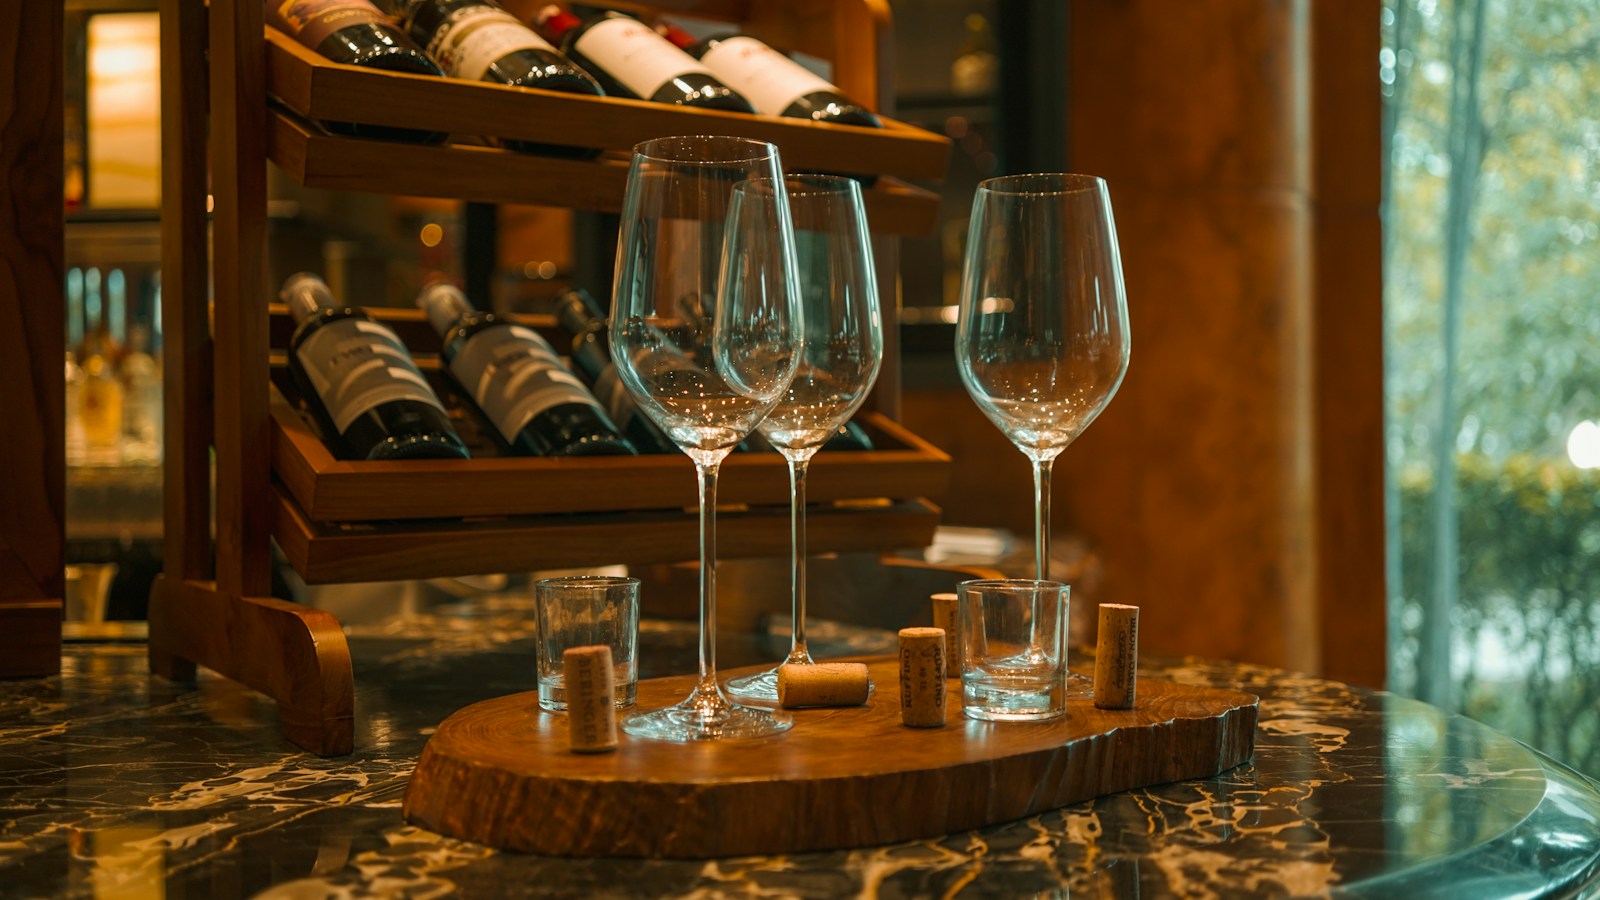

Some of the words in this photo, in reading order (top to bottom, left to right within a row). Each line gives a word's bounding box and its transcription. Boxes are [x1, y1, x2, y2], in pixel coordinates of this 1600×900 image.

[1129, 617, 1137, 651] NOTRI
[578, 658, 598, 744] BERINGER
[903, 649, 912, 708] RUFFINO
[933, 647, 943, 708] RUFFINO
